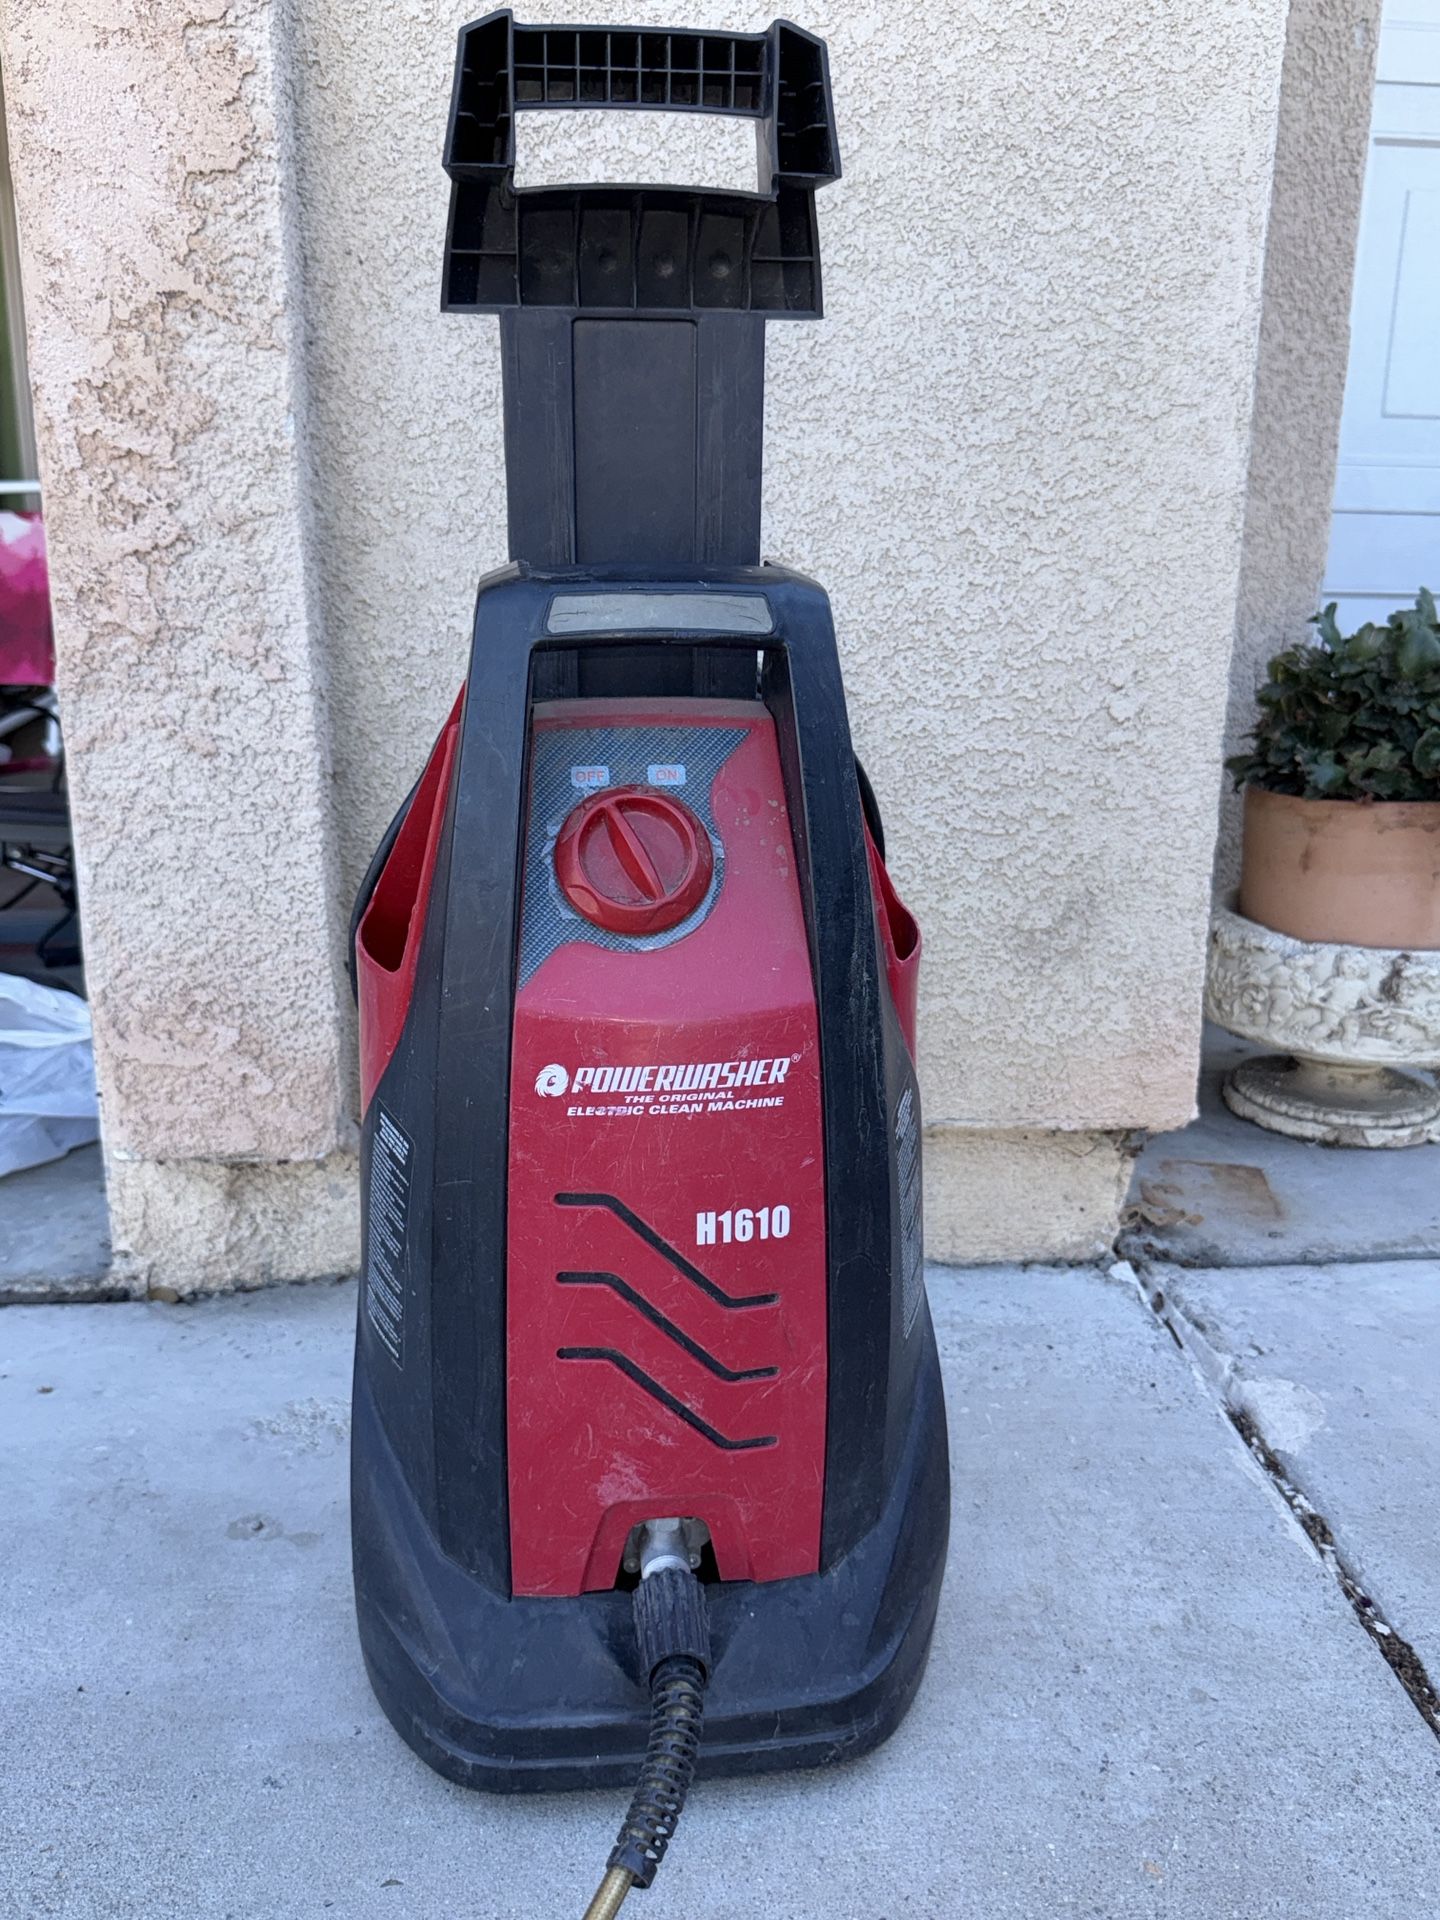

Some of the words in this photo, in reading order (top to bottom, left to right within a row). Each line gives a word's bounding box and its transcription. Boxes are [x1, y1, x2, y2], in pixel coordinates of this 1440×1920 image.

[575, 771, 605, 783] OFF
[656, 769, 678, 781] ON
[571, 1057, 791, 1094] POWERWASHER
[624, 1095, 654, 1104] THE
[659, 1091, 735, 1103] ORIGINAL
[567, 1105, 644, 1117] ELECTRIC
[648, 1103, 703, 1115] CLEAN
[707, 1096, 785, 1112] MACHINE
[695, 1204, 791, 1246] H1610
